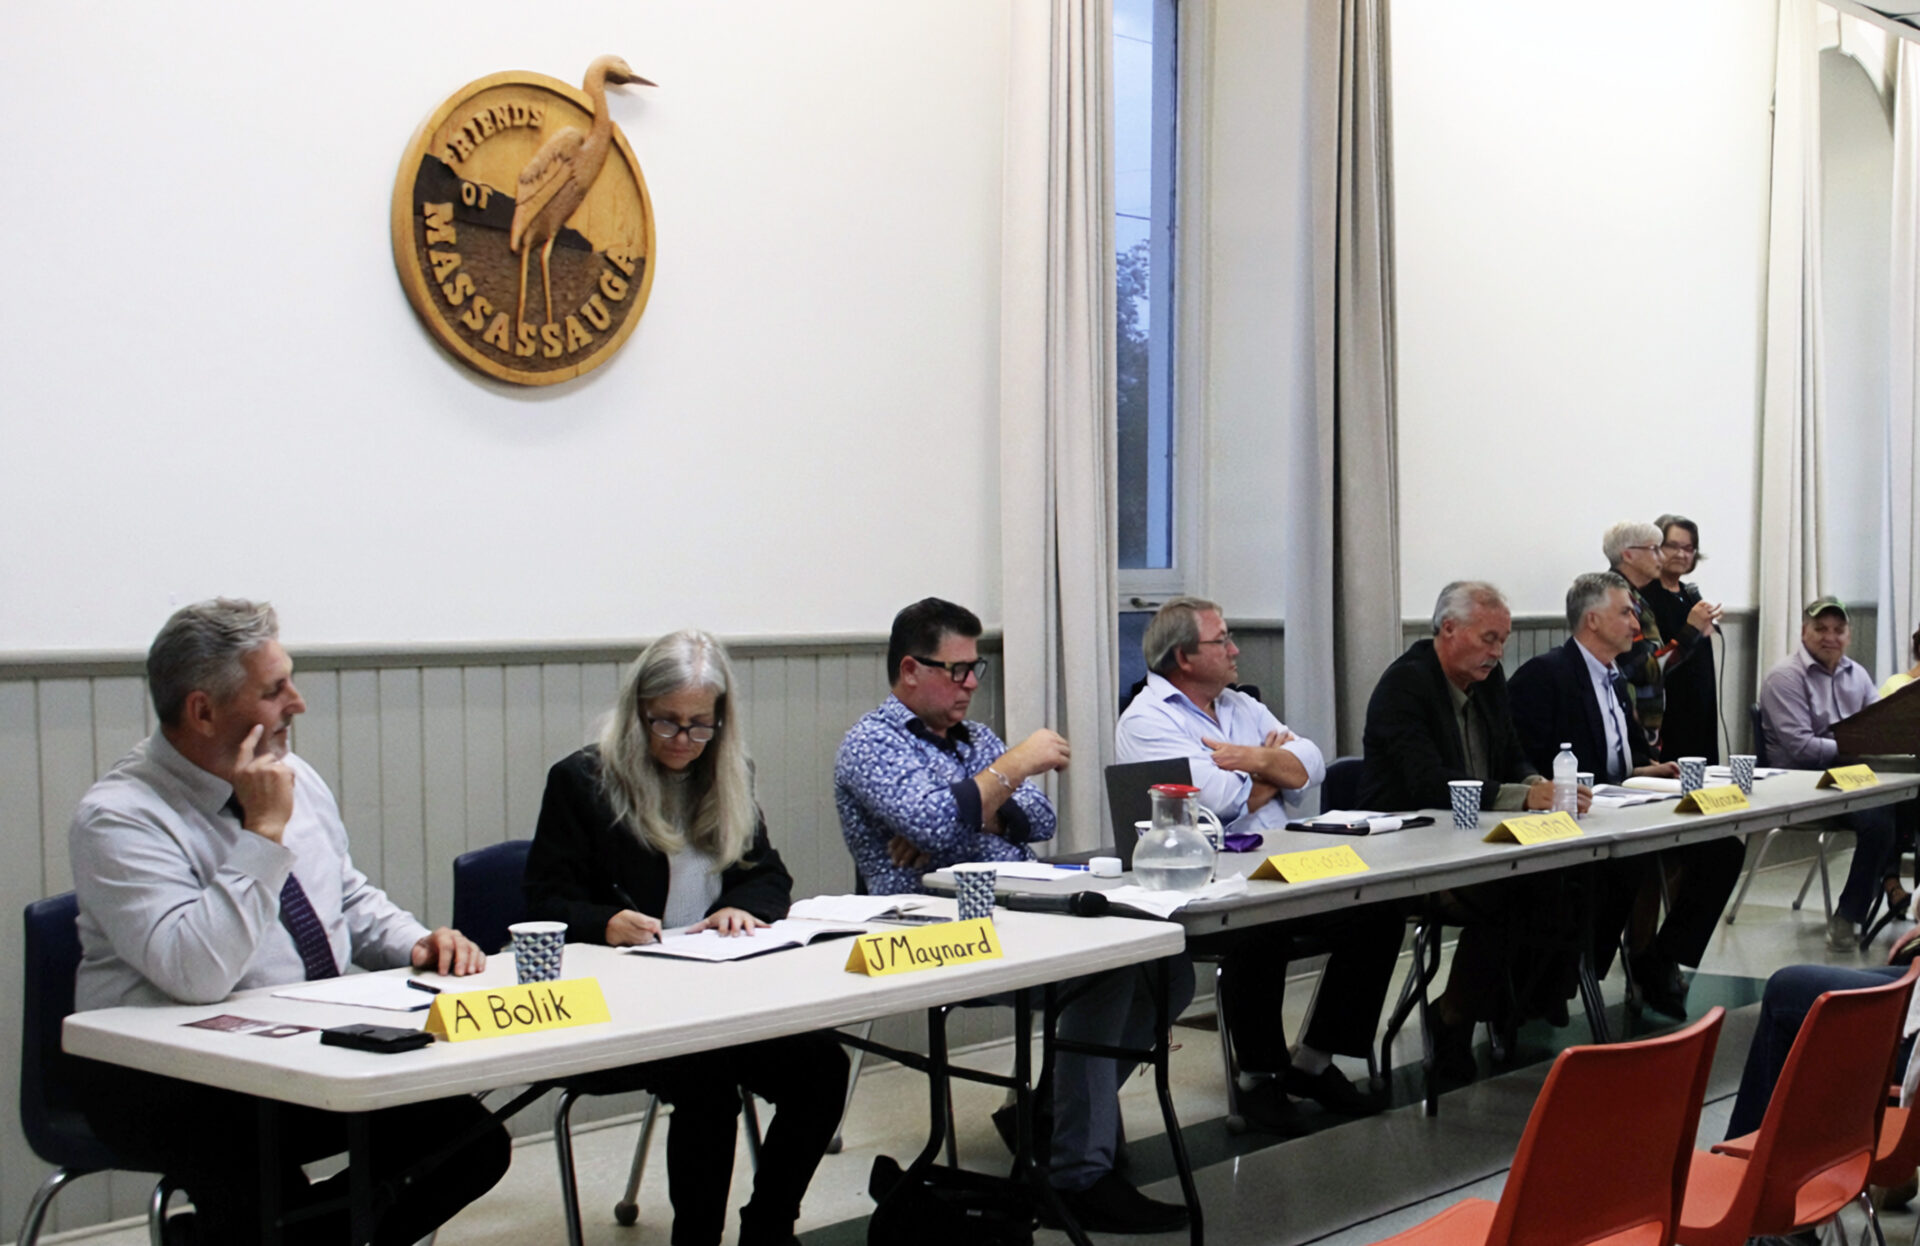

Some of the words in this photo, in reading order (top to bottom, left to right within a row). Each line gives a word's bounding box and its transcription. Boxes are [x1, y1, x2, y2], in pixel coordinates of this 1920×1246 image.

[441, 104, 544, 167] FRIENDS
[461, 181, 493, 209] OF
[422, 202, 637, 358] MASSASSAUGA
[455, 999, 481, 1034] A
[487, 989, 571, 1030] Bolik
